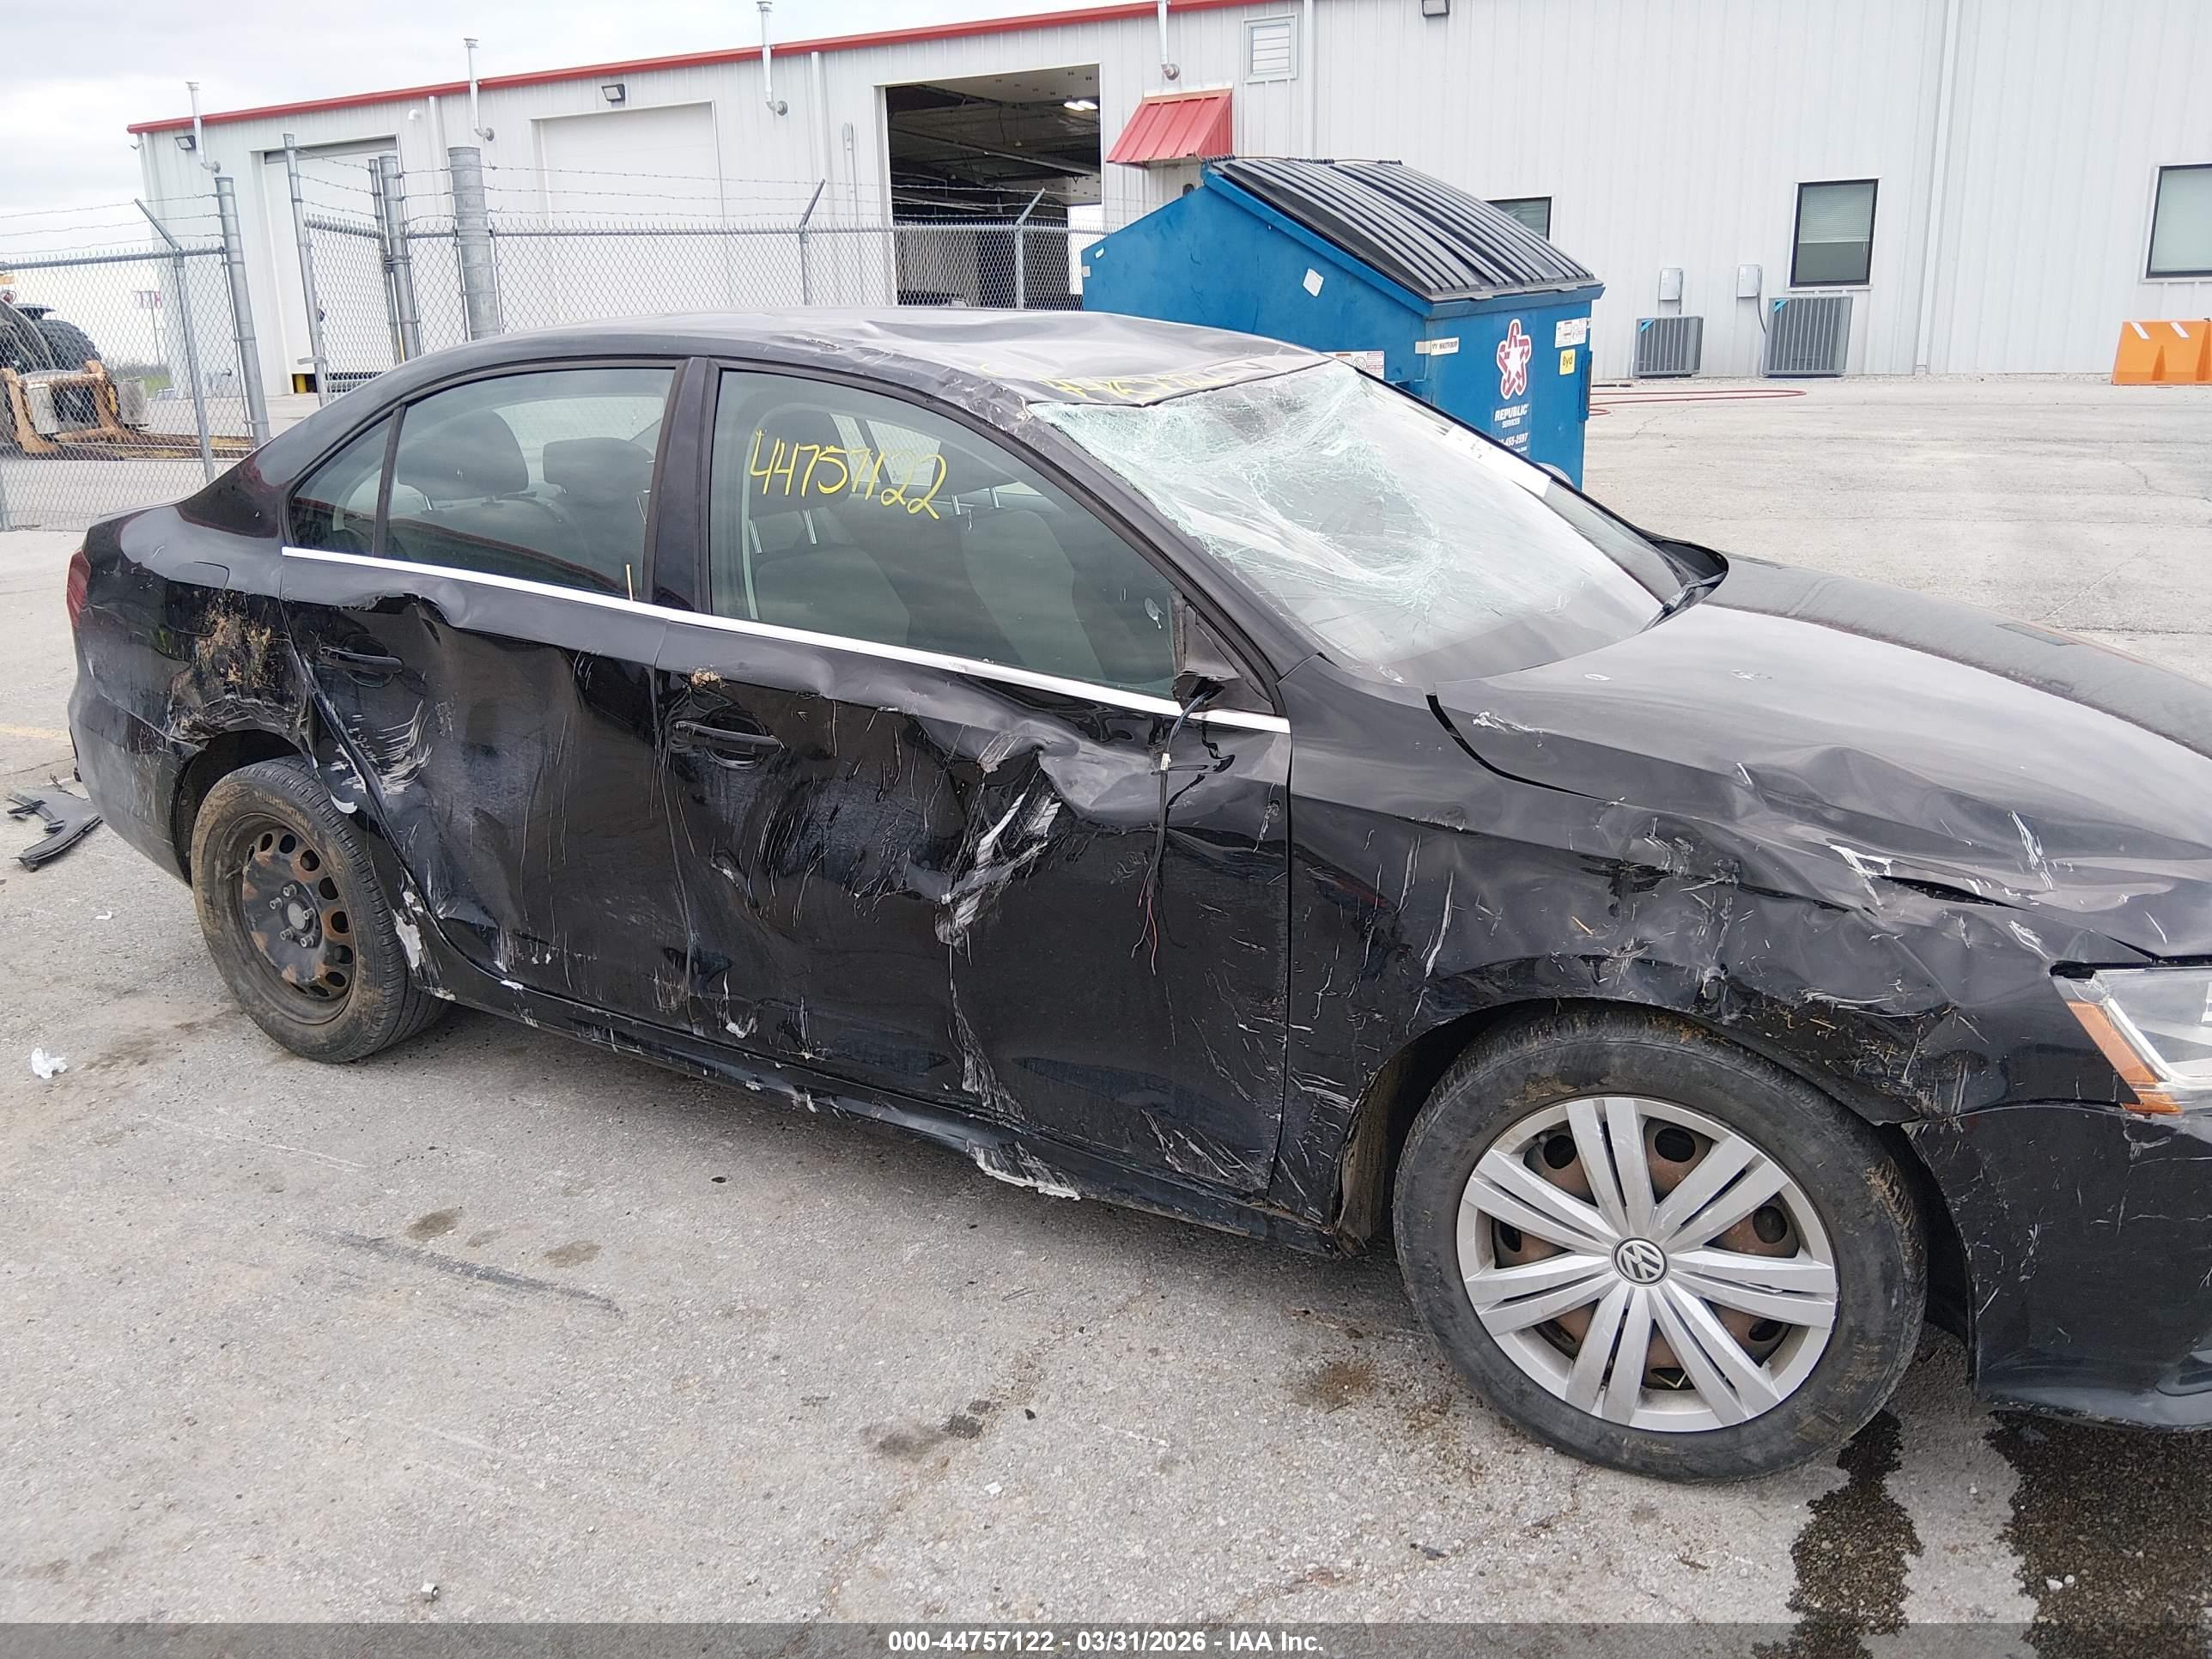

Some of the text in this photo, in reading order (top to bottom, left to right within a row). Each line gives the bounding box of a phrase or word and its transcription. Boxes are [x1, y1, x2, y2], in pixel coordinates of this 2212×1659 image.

[1494, 404, 1528, 422] REPUBLIC
[1502, 417, 1521, 428] SERVICES
[750, 429, 947, 520] 44757122
